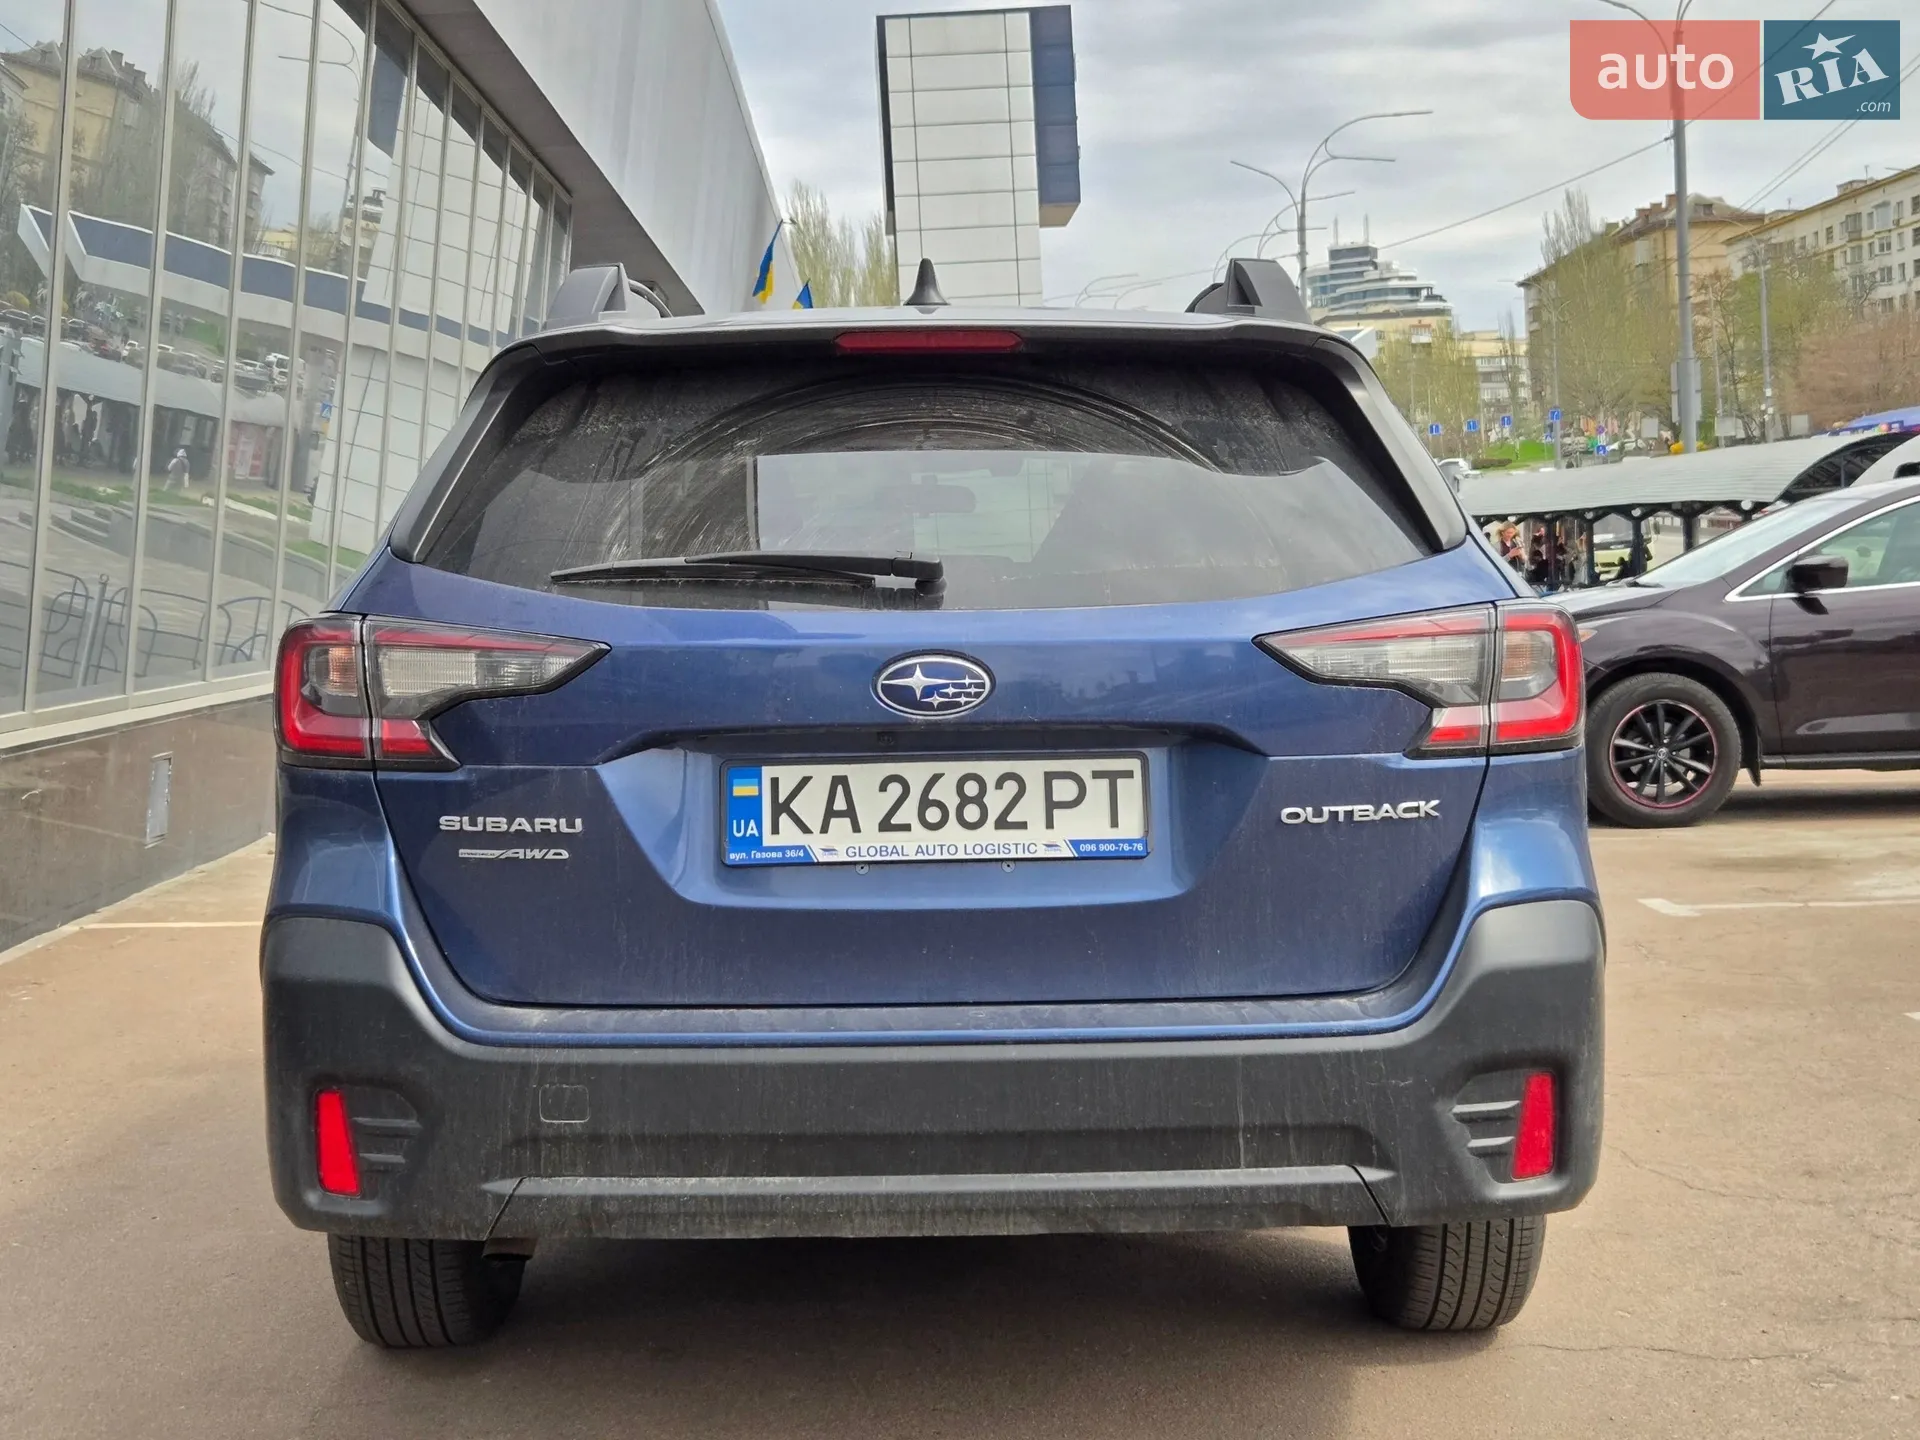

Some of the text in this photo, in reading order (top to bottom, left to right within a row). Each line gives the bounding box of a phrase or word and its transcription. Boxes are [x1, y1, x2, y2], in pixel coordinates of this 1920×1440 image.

[770, 770, 1135, 836] KA 2682 PT
[1280, 800, 1440, 824] OUTBACK
[439, 815, 583, 833] SUBARU
[733, 819, 759, 838] UA
[500, 848, 570, 860] AWD
[750, 850, 782, 859] Газова
[784, 849, 804, 859] 36/4
[845, 846, 908, 859] GLOBAL
[914, 844, 960, 857] AUTO
[964, 842, 1038, 856] LOGISTIC
[1079, 842, 1144, 852] 096 900-76-76
